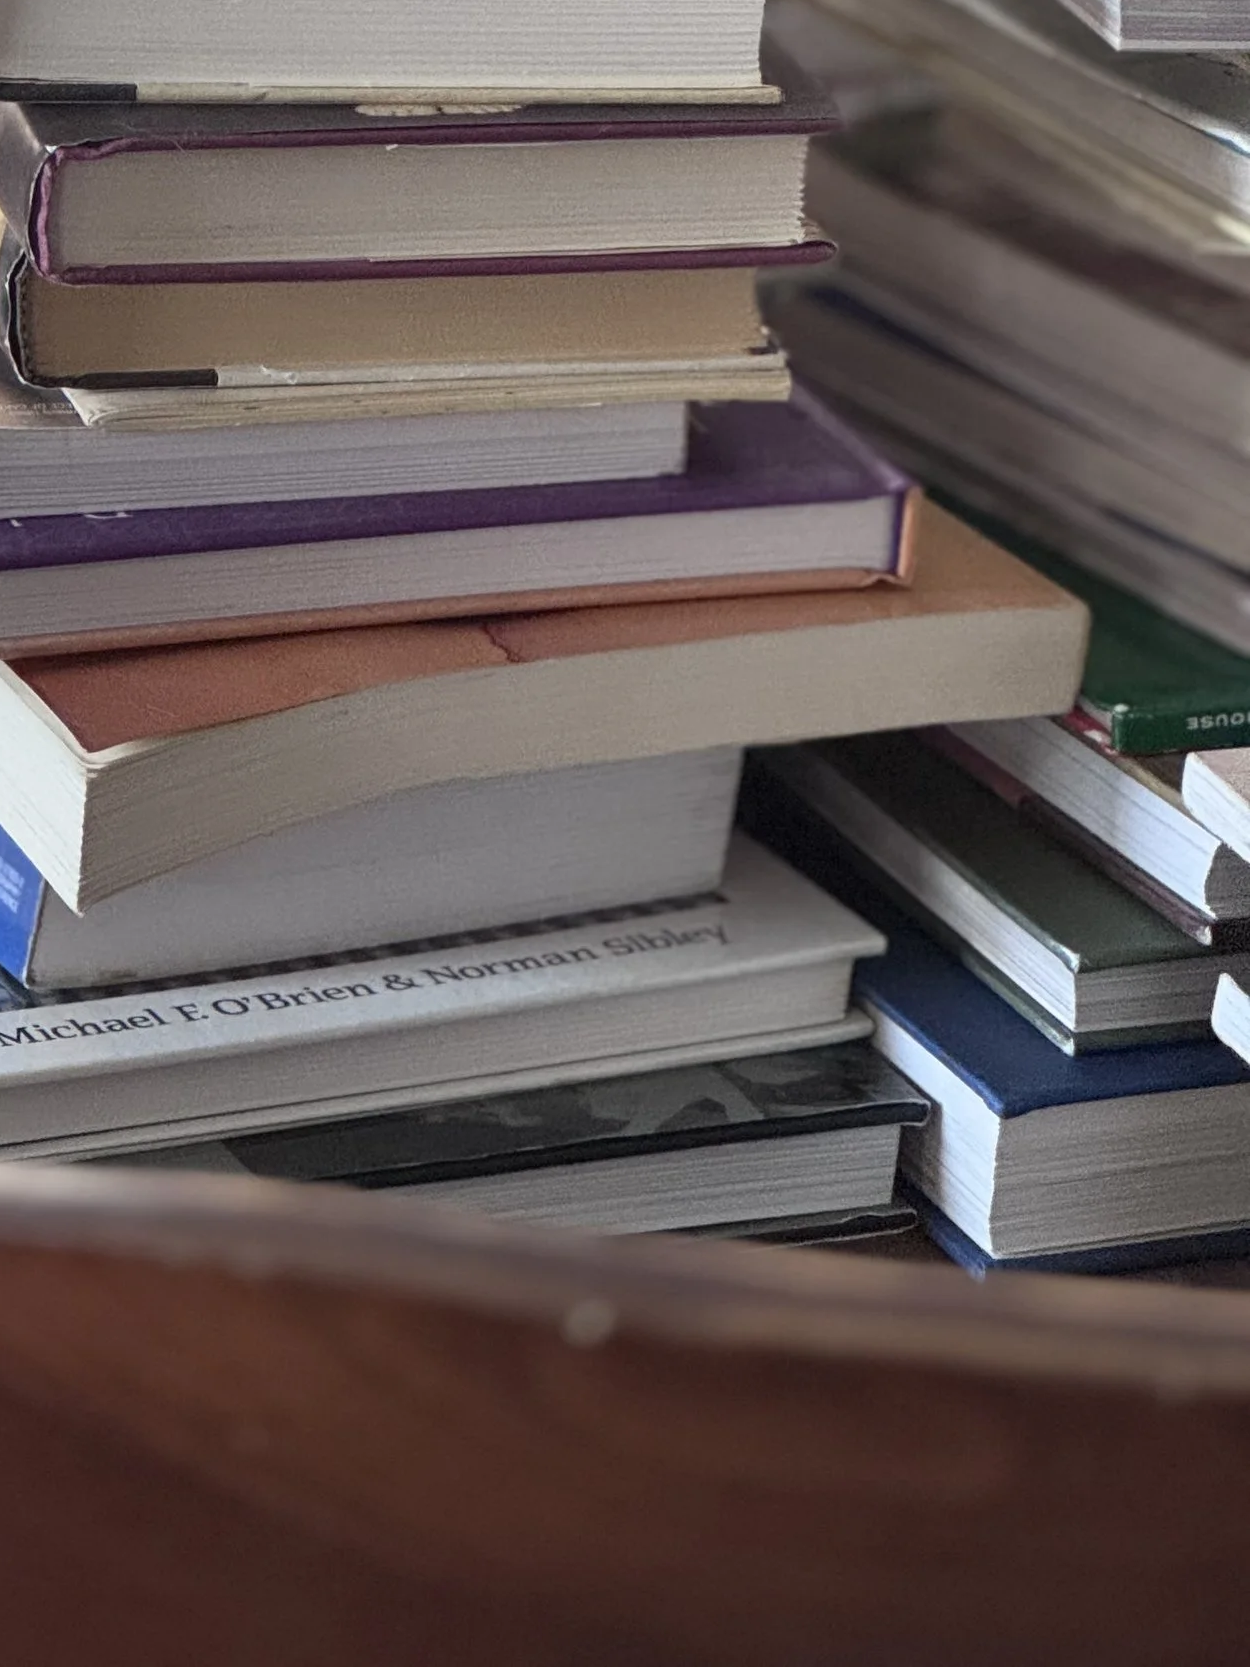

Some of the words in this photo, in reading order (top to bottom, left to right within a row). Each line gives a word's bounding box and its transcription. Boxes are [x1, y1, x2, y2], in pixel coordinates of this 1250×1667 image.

[1186, 711, 1250, 731] OUSE
[211, 982, 376, 1018] O'Brien
[381, 973, 418, 993] &
[425, 944, 602, 986] Norman
[602, 922, 732, 959] Sibley
